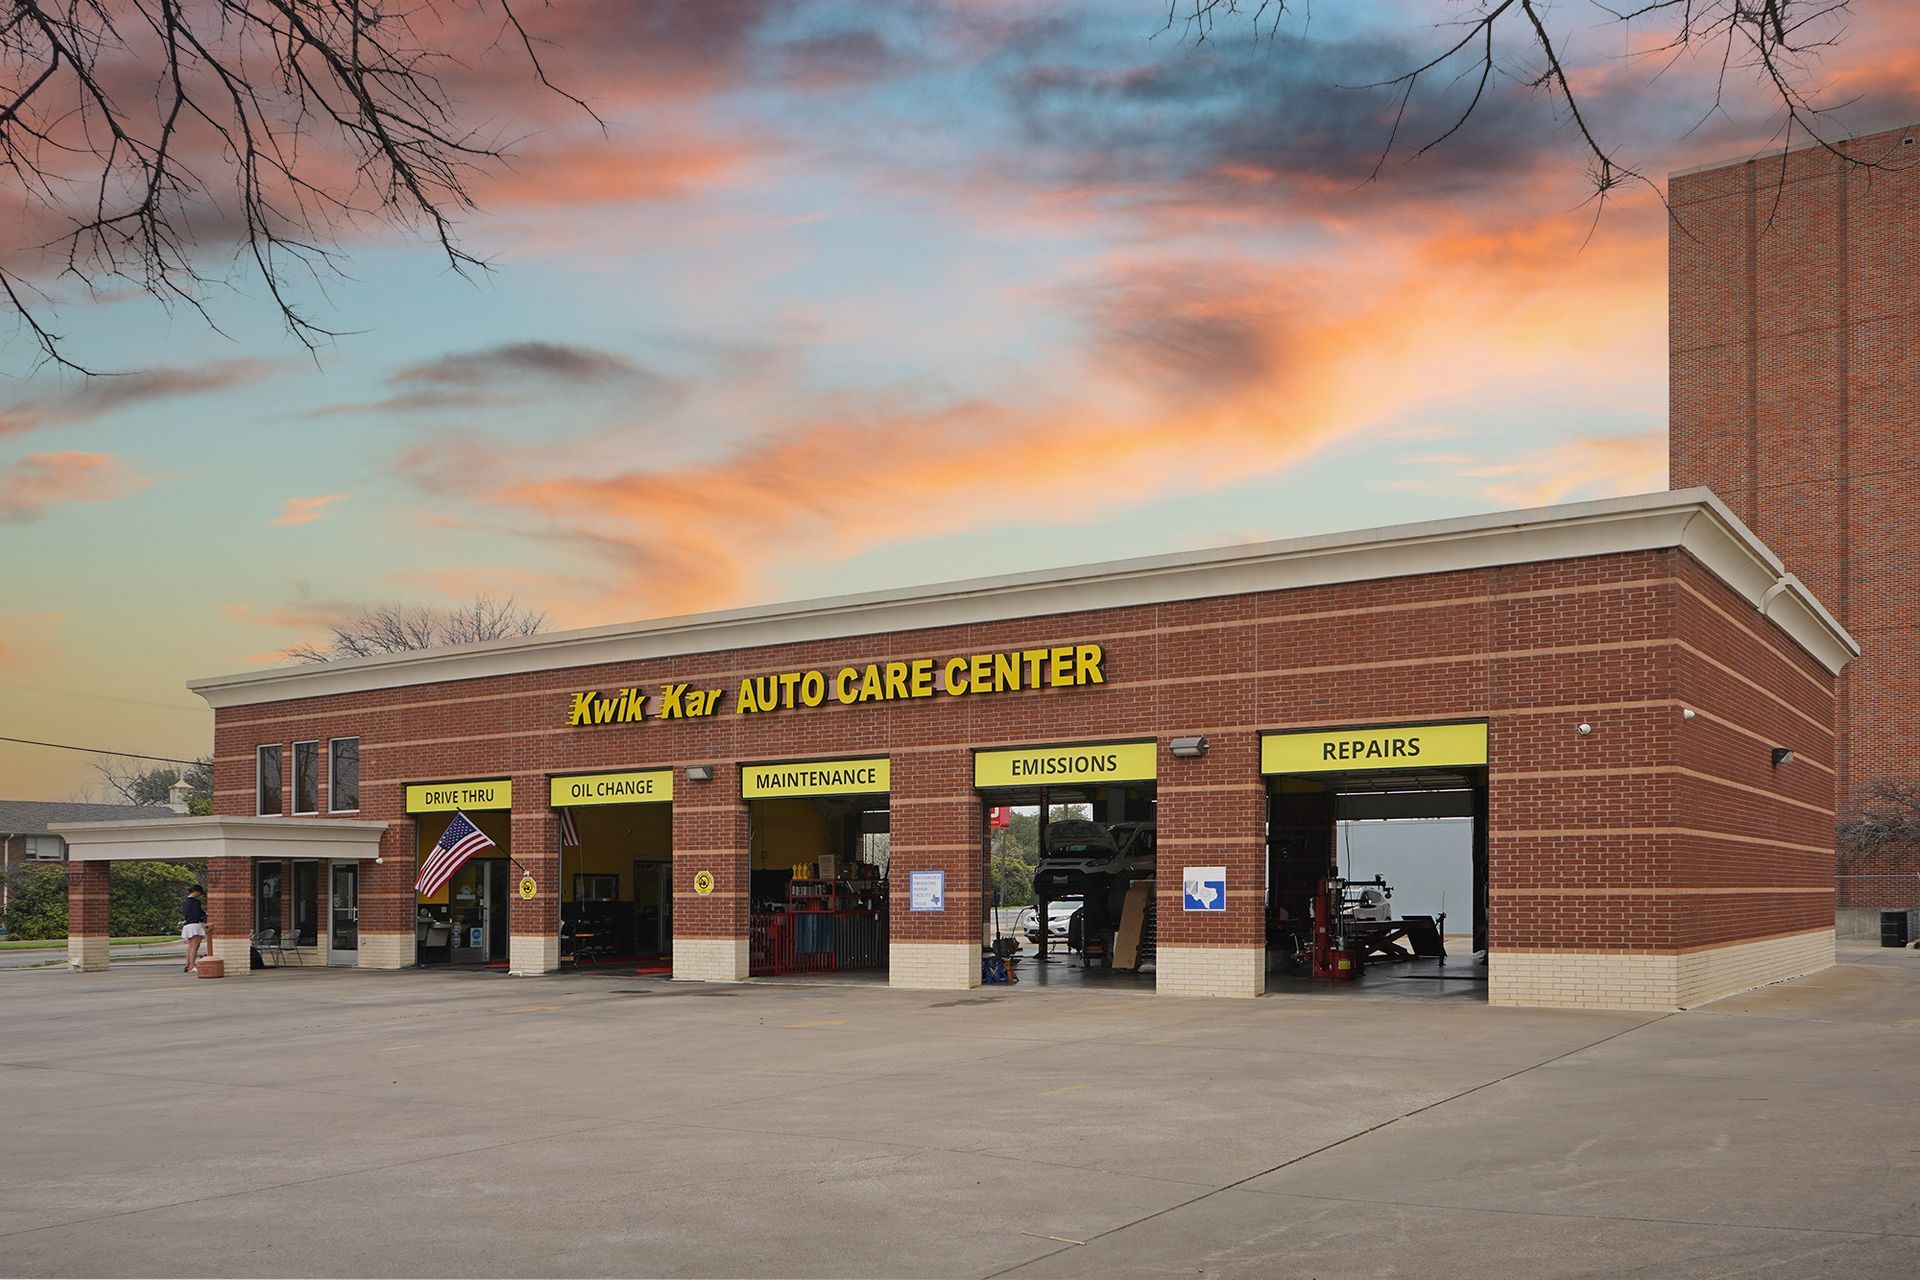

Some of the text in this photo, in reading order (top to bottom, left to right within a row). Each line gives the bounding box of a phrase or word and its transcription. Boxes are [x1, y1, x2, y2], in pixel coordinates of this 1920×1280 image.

[566, 644, 1105, 726] Kwik Kar AUTO CARE CENTER
[1323, 737, 1421, 761] REPAIRS
[1011, 754, 1118, 777] EMISSIONS
[571, 779, 654, 798] OIL CHANGE
[755, 768, 877, 790] MAINTENANCE
[425, 788, 495, 805] DRIVE THRU
